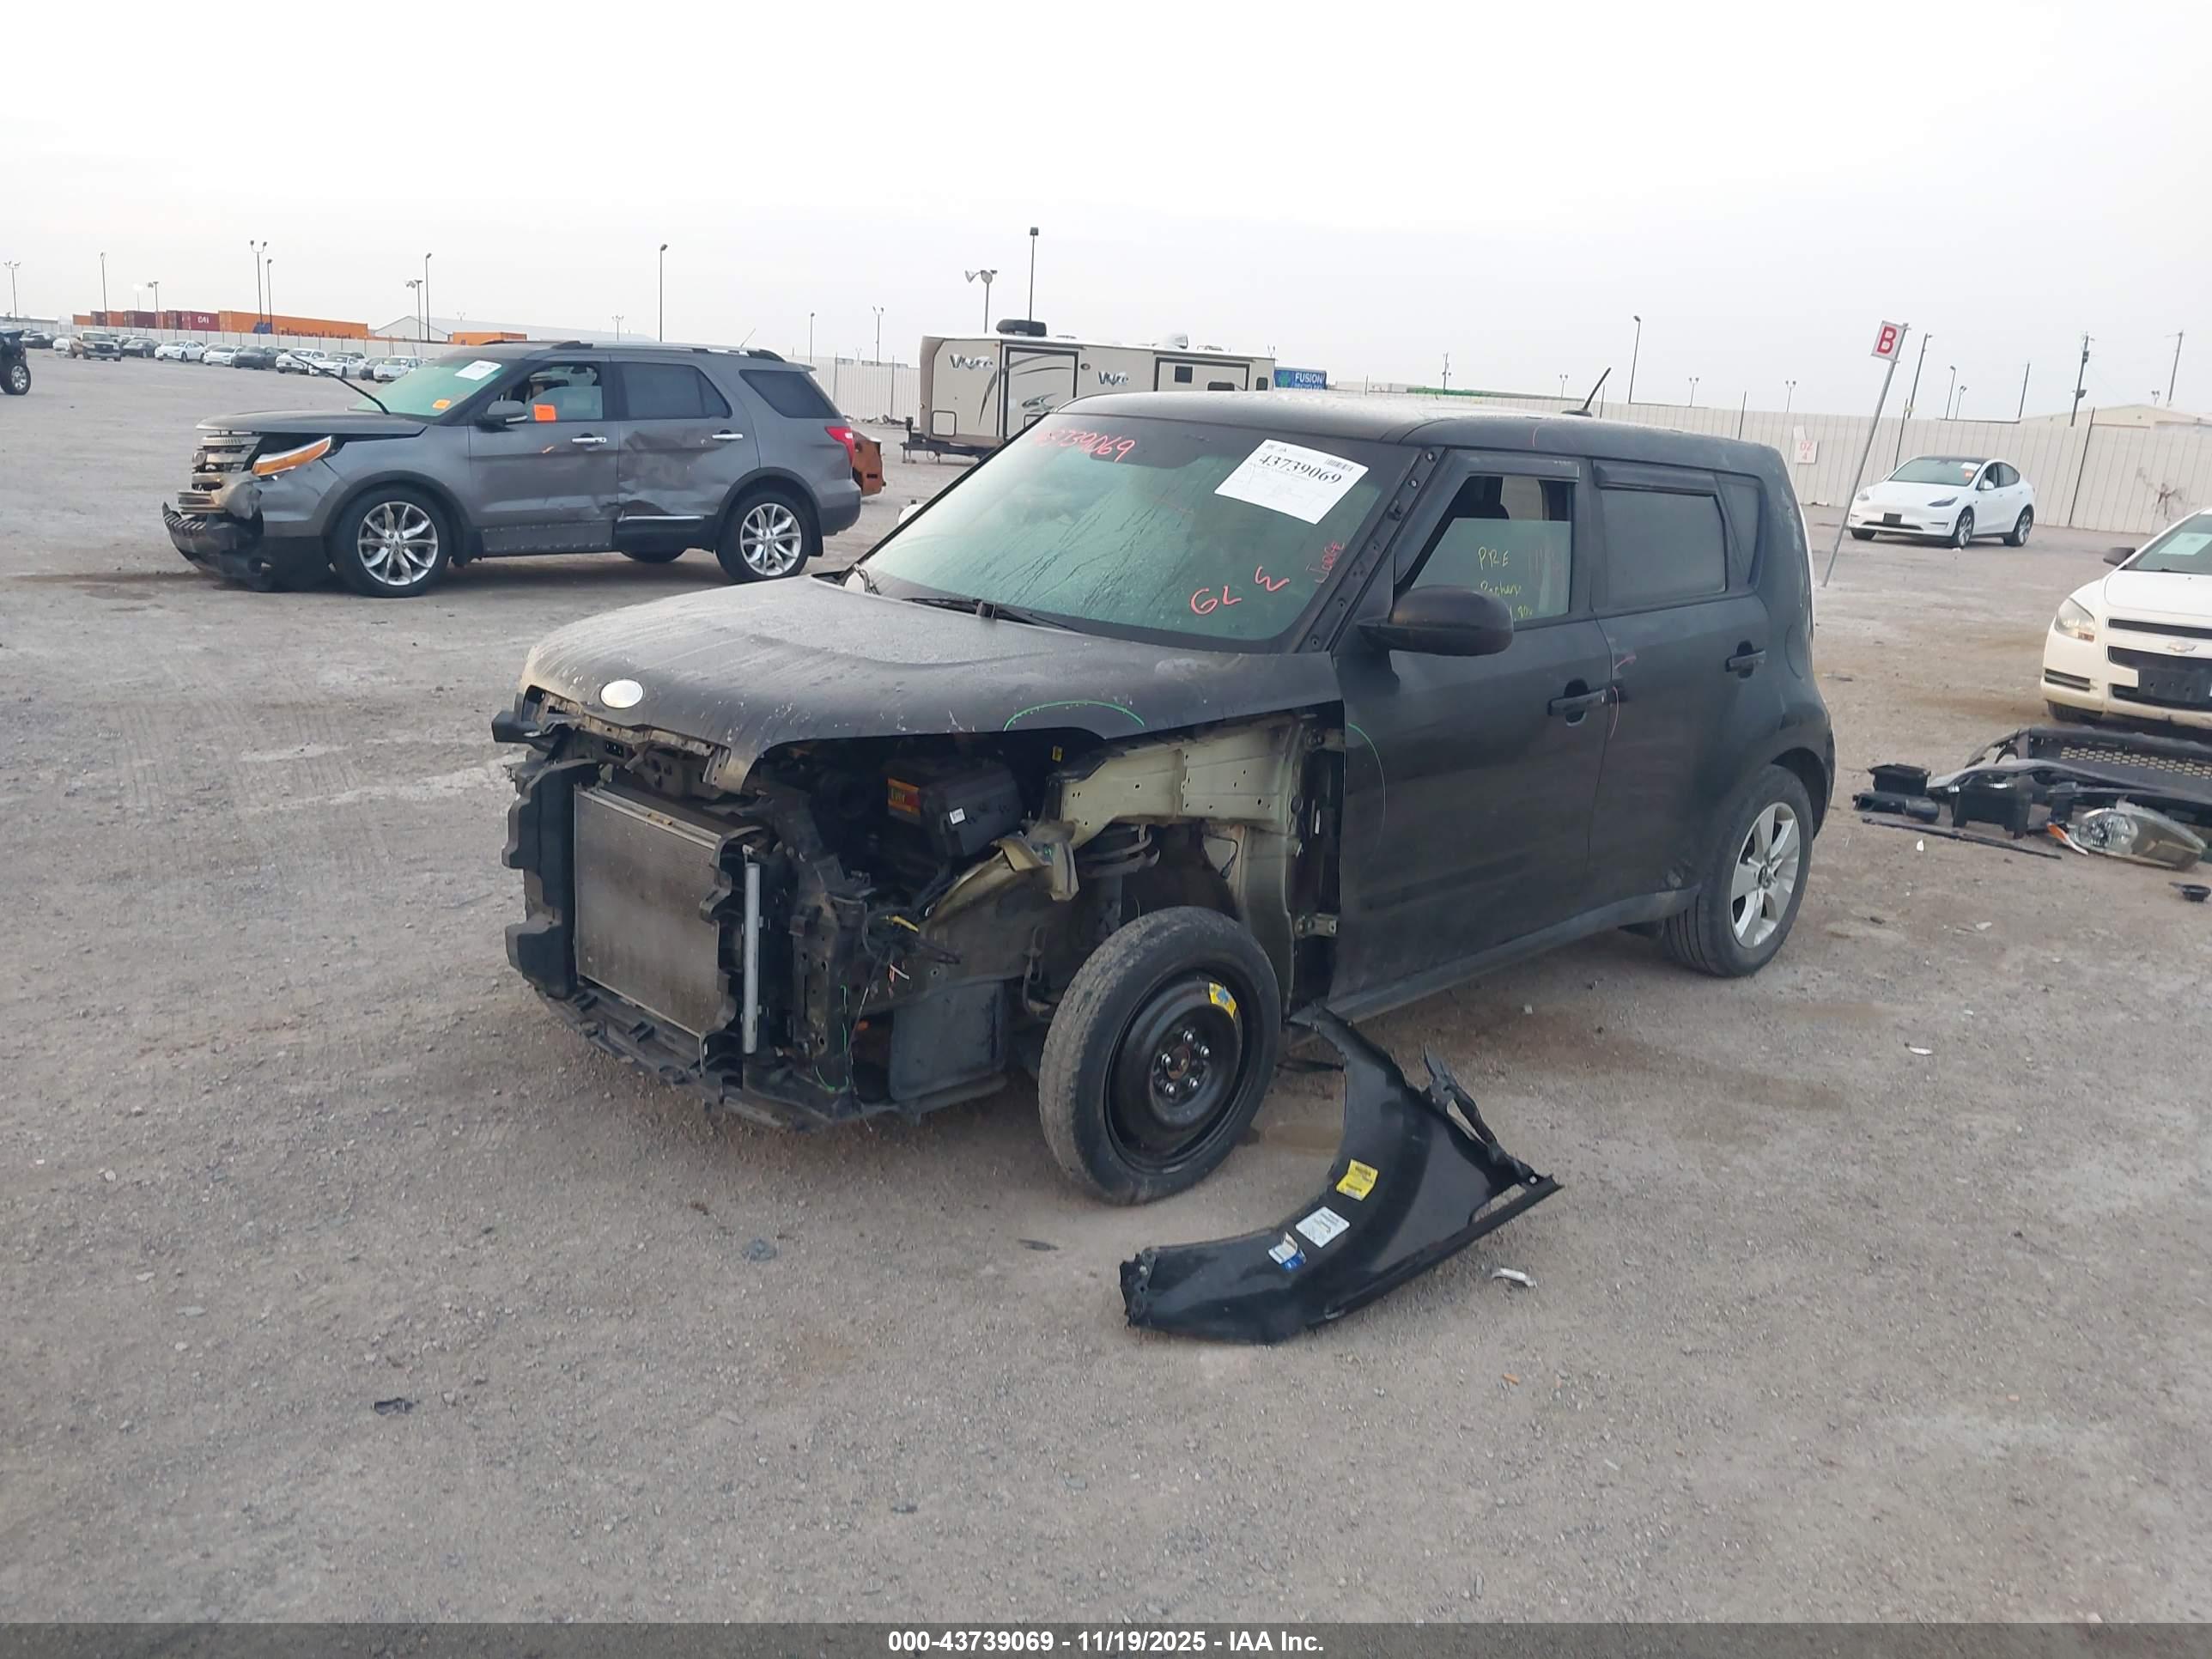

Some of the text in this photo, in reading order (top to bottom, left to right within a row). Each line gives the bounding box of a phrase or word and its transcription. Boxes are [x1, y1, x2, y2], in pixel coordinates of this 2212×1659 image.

[1877, 325, 1897, 354] B
[1295, 372, 1325, 384] FUSION
[1035, 428, 1135, 462] 739069
[1259, 454, 1342, 483] 43739069
[1478, 546, 1509, 570] PRE
